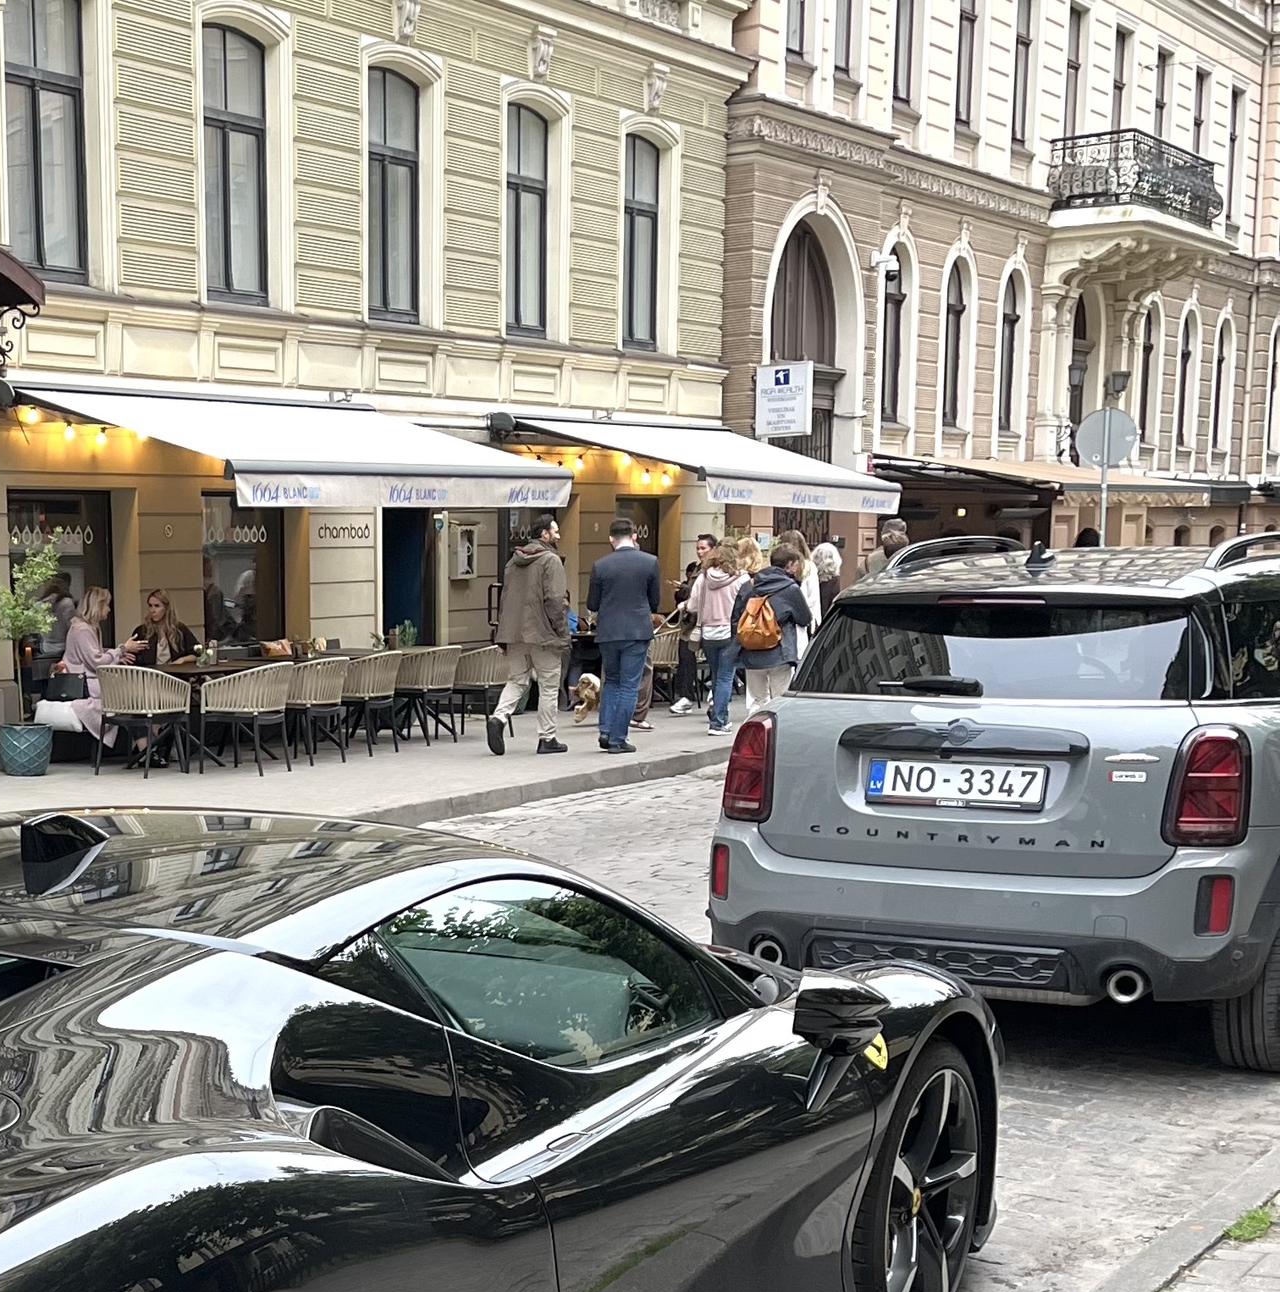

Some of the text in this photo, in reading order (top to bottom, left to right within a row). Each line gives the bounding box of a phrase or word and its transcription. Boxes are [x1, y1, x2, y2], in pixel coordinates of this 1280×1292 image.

[252, 482, 280, 503] 1664
[283, 486, 307, 500] BLANC
[389, 482, 414, 504] 1664
[415, 488, 436, 501] BLANC
[508, 481, 530, 504] 1664
[870, 780, 883, 789] LV
[809, 824, 1105, 849] COUNTRYMAN
